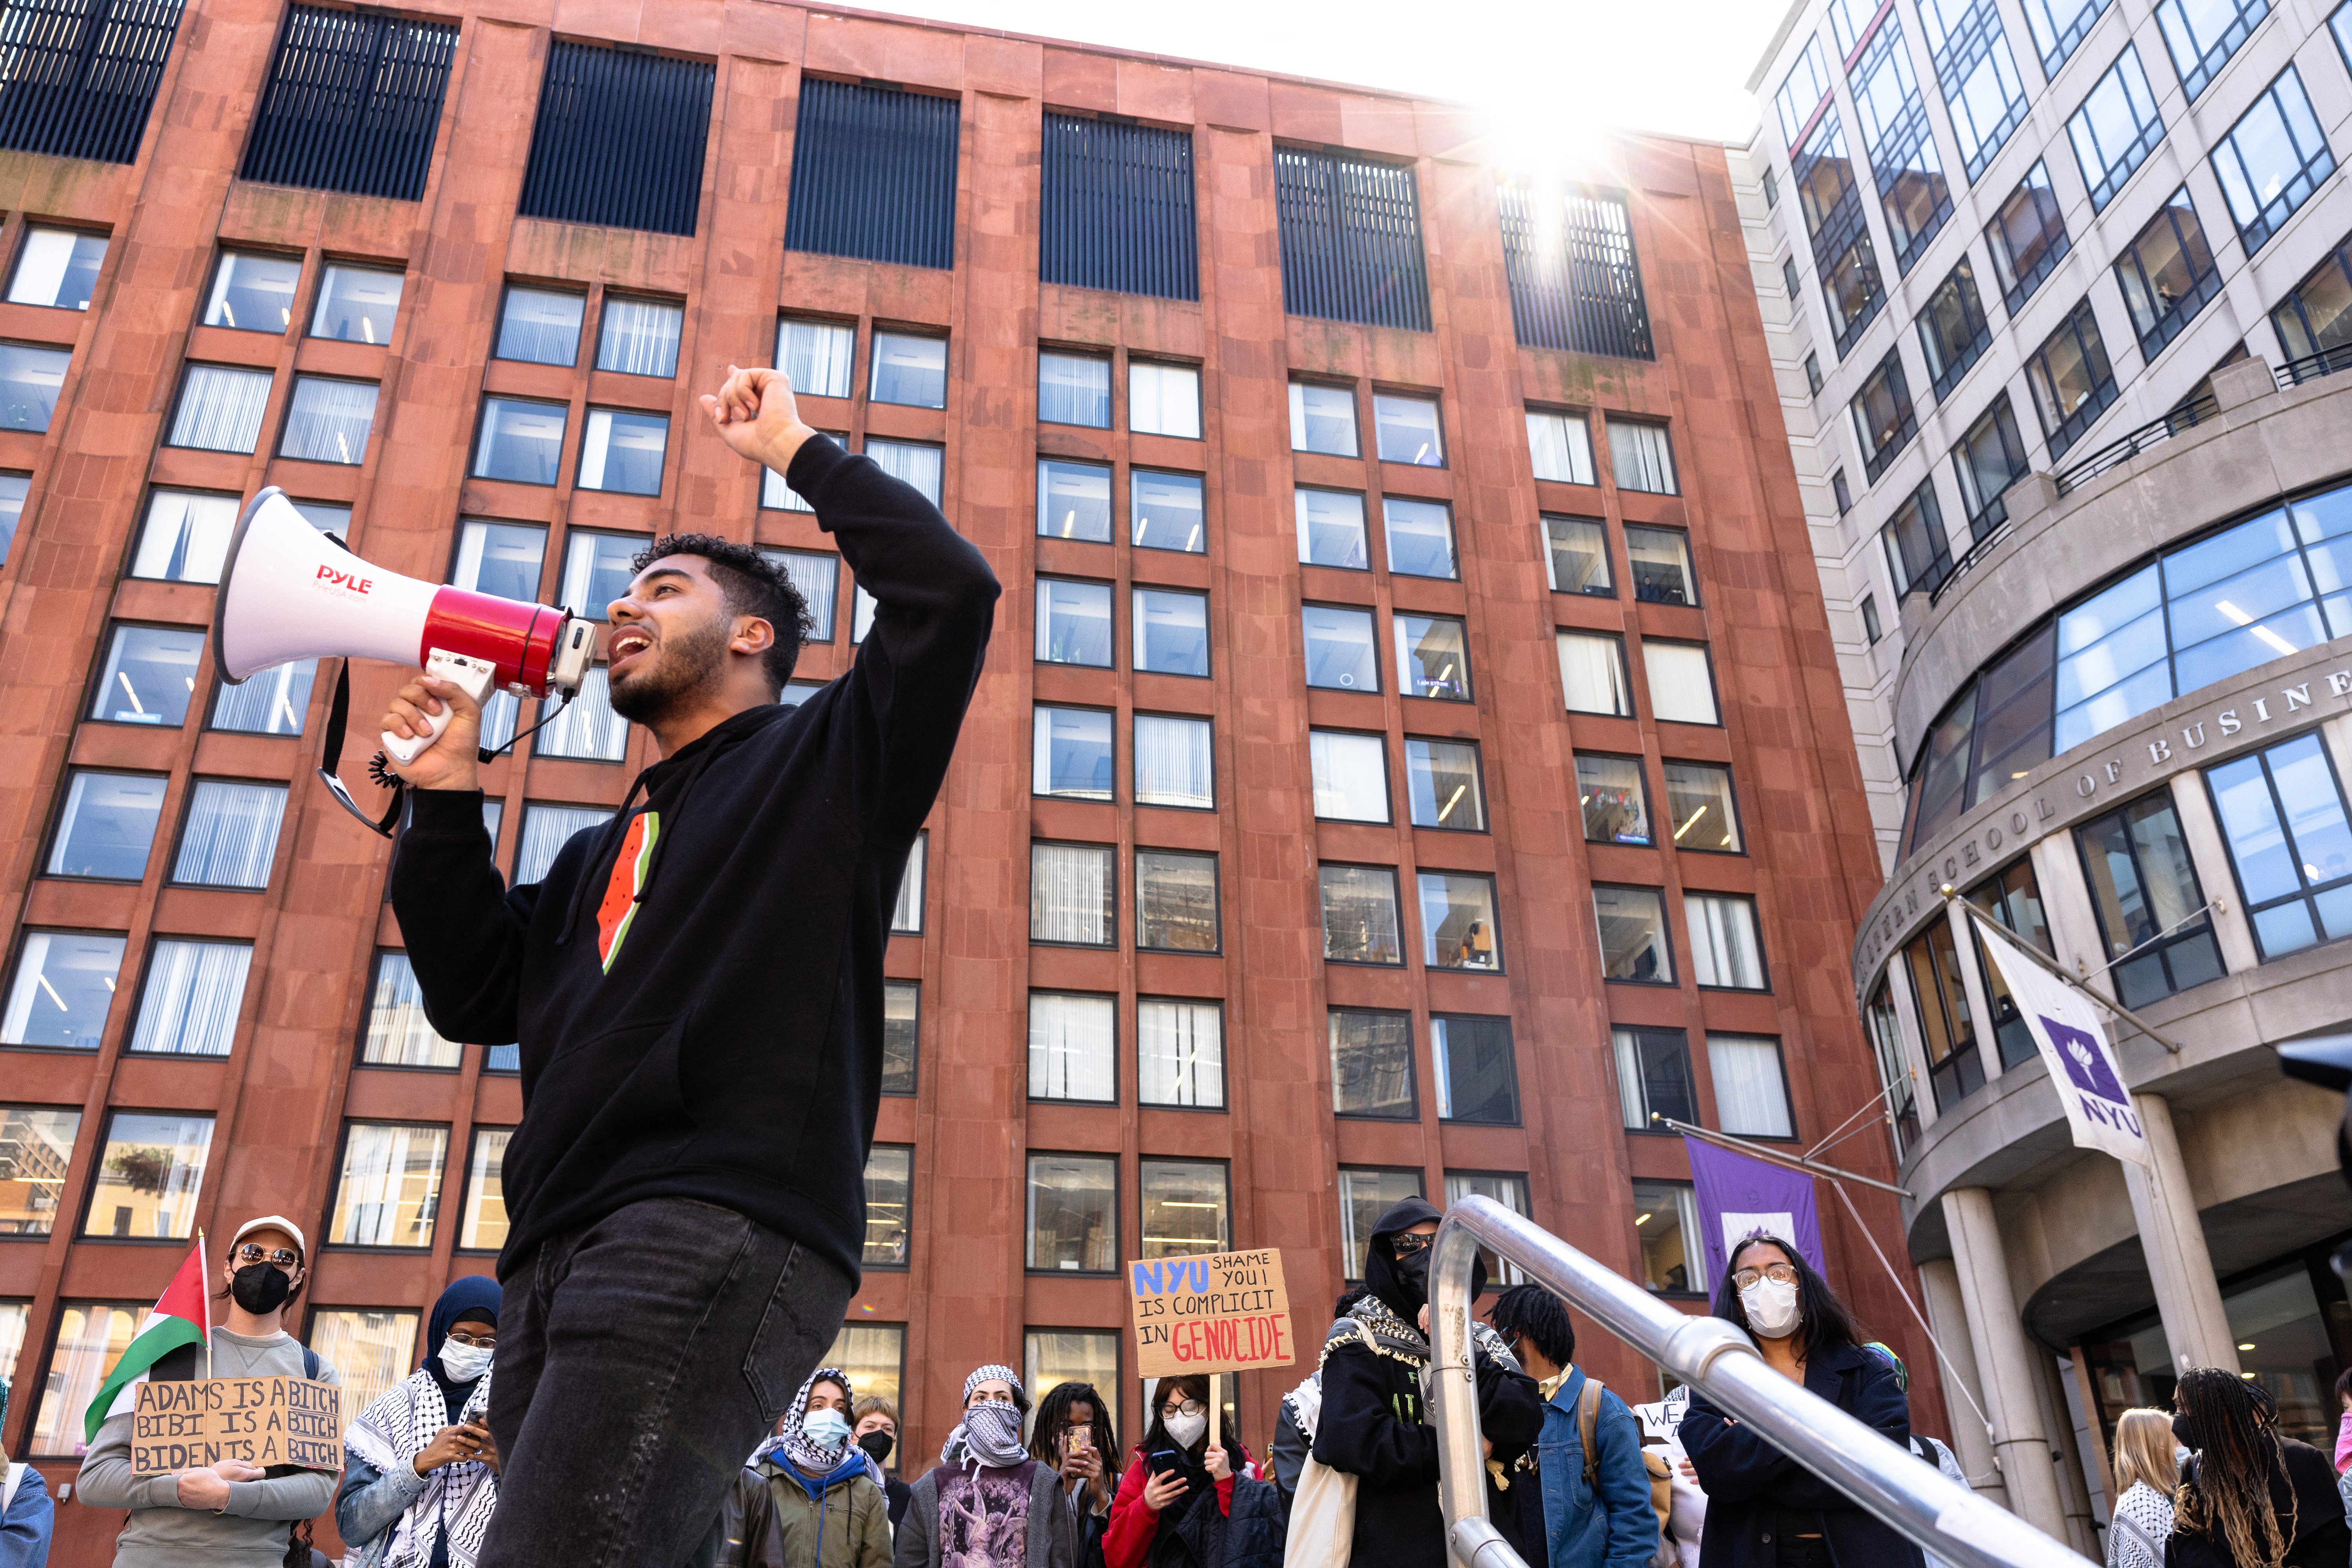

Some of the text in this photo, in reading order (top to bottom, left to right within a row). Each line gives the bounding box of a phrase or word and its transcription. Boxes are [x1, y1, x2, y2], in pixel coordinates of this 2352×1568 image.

[313, 580, 367, 604] PyleUSA.com
[316, 564, 372, 594] PYLE
[1928, 798, 2055, 894] SCHOOL
[2077, 758, 2123, 798] OF
[2079, 1093, 2142, 1138] NYU
[1213, 1253, 1270, 1269] SHAME
[1133, 1260, 1209, 1296] NYU
[1139, 1290, 1274, 1317] IS COMPLICIT
[1140, 1314, 1290, 1362] IN GENOCIDE
[138, 1379, 338, 1414] ADAMS IS A BITCH
[137, 1410, 338, 1438] BIBI IS A BITCH
[1644, 1404, 1681, 1427] WE
[134, 1436, 338, 1472] BIDEN IS A BITCH
